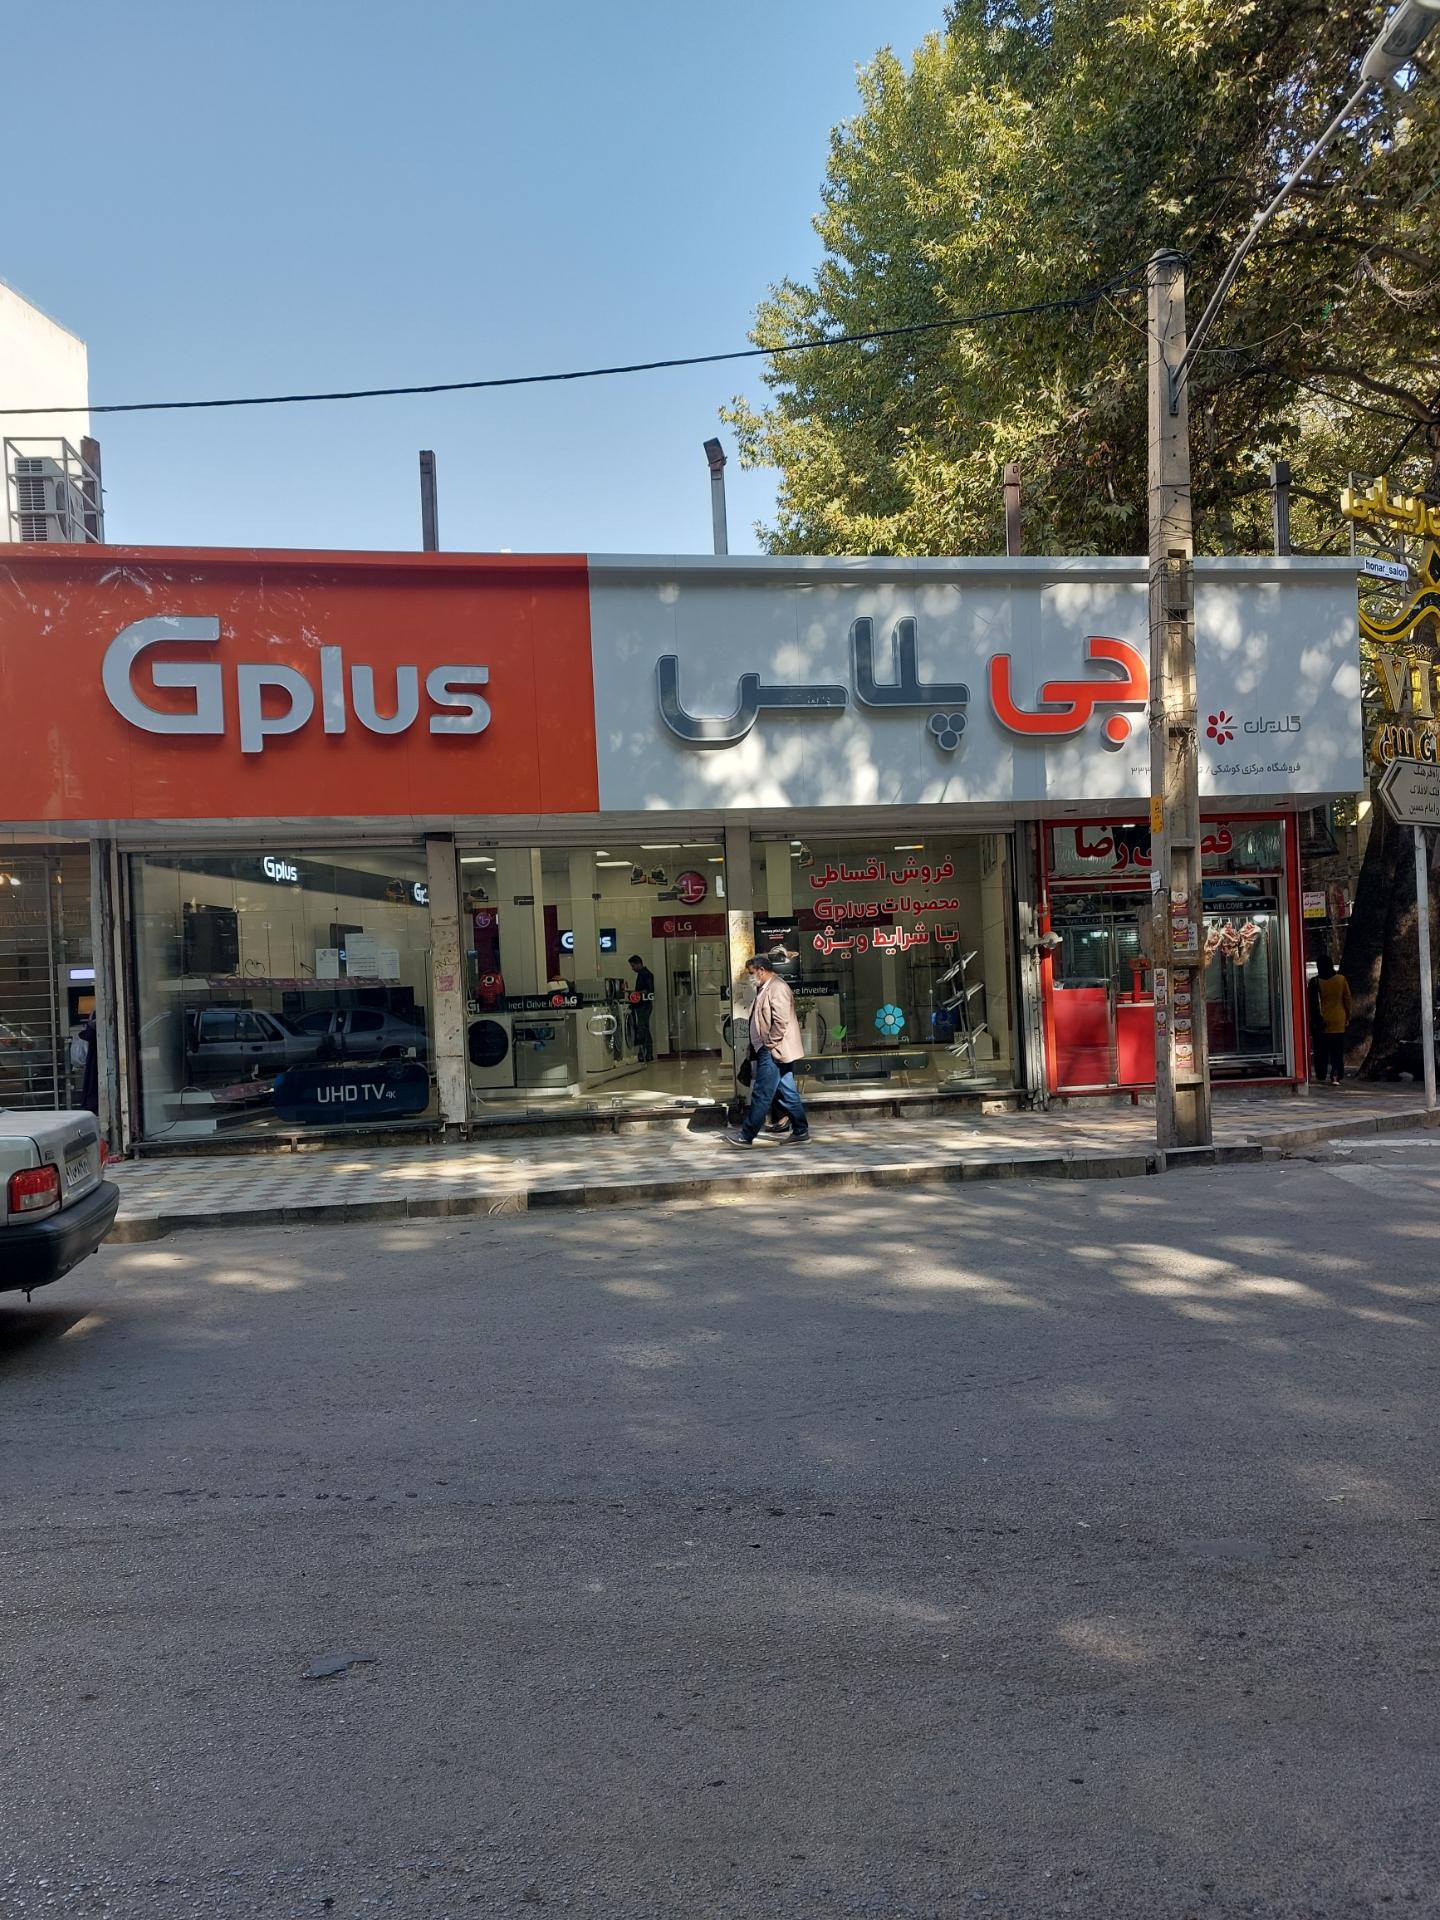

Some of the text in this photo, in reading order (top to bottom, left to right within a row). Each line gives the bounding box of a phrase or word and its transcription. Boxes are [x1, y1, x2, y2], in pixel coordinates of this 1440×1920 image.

[1366, 560, 1408, 577] honar_salon
[102, 615, 492, 753] Gplus
[656, 616, 1149, 751] جی پلاس
[1380, 654, 1440, 719] VI
[1243, 715, 1302, 734] گلدیران
[1211, 764, 1240, 776] کوشکی
[1241, 763, 1264, 775] مرکزی
[1266, 762, 1301, 774] فروشگاه
[1074, 826, 1129, 870] رضا
[263, 857, 298, 882] Gplus
[809, 855, 954, 890] فروش اقساطی
[813, 898, 879, 922] Gplus
[881, 896, 960, 917] محصولات
[1212, 902, 1244, 911] WELCOME
[678, 922, 693, 931] LG
[813, 921, 960, 959] با شرایط ویژه
[565, 996, 577, 1004] LG
[642, 993, 654, 1001] LG
[801, 987, 829, 995] Inverter
[317, 1085, 358, 1103] UHD
[361, 1083, 386, 1100] TV
